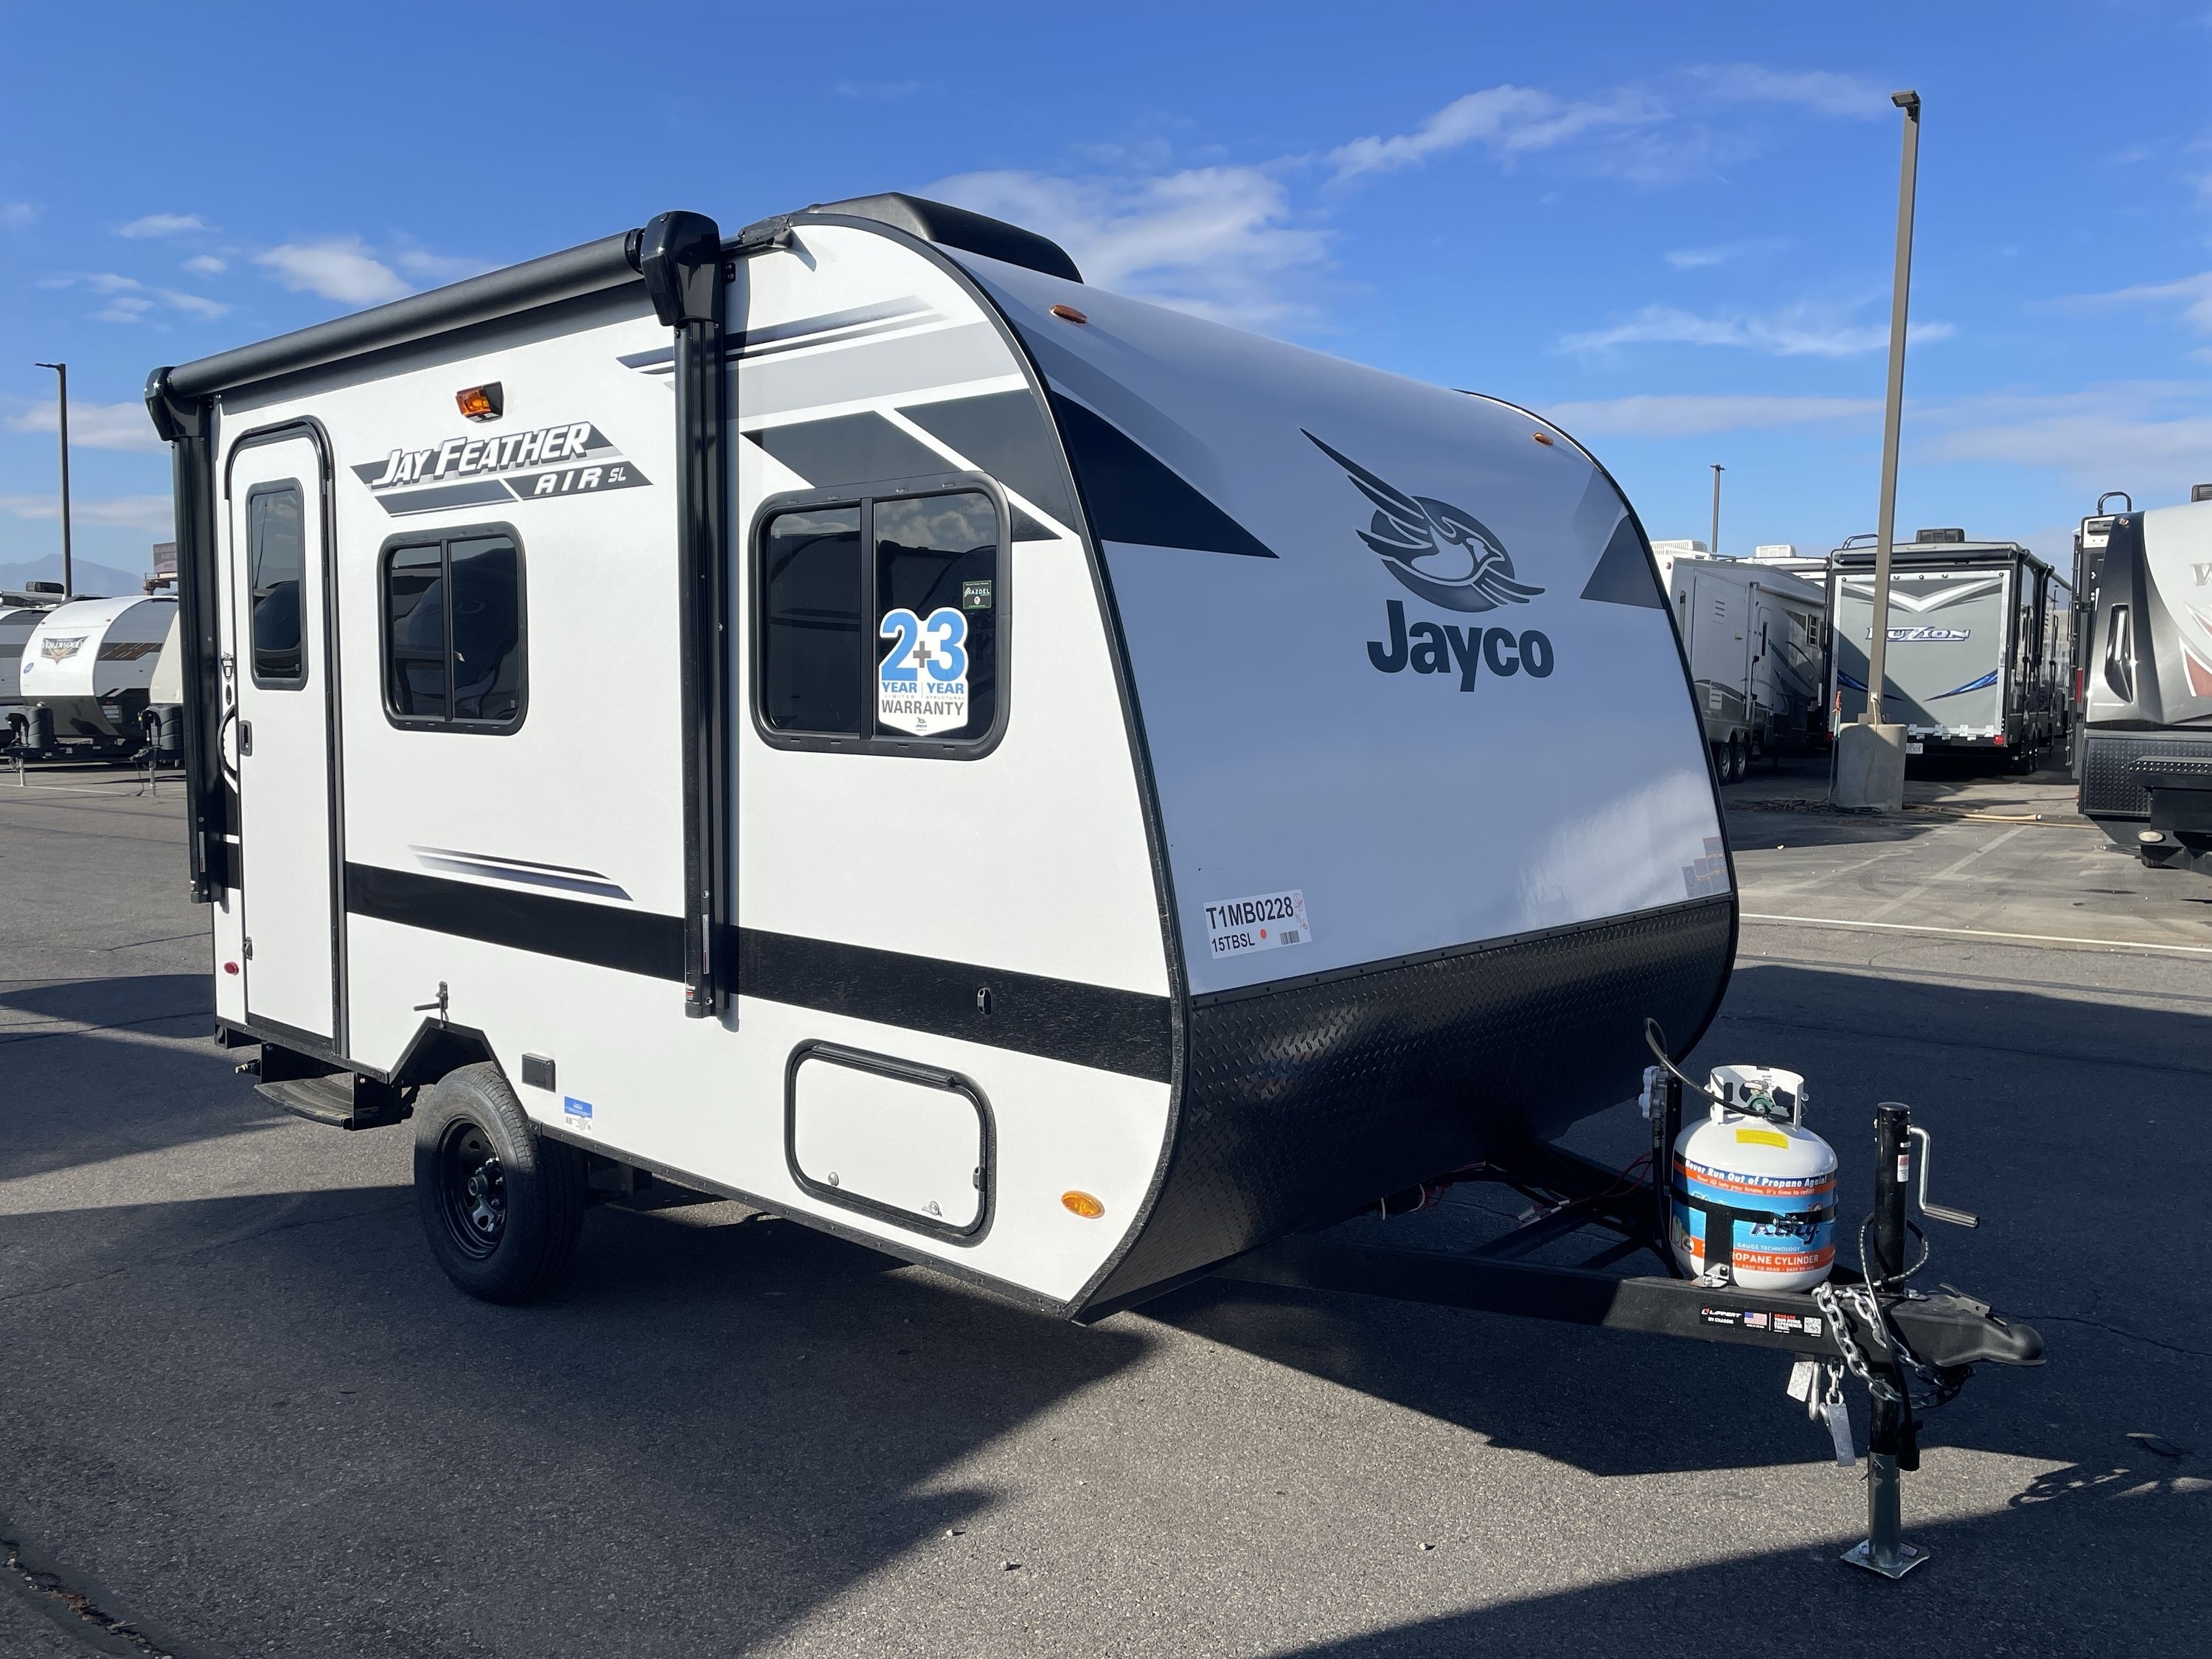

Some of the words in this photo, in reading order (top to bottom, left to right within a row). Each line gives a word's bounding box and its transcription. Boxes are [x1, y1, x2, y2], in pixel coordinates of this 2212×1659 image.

[371, 448, 431, 490] JAY
[434, 421, 591, 479] FEATHER
[533, 467, 602, 495] AIR
[608, 467, 627, 483] SL
[1865, 626, 1971, 642] UZION
[1366, 599, 1554, 692] Jayco
[881, 682, 917, 693] YEAR
[926, 683, 964, 694] YEAR
[881, 699, 964, 715] WARRANTY
[1206, 897, 1294, 929] T1MB0228
[1211, 932, 1256, 953] 15TBSL
[1685, 1159, 1706, 1174] Never
[1707, 1167, 1725, 1179] Run
[1727, 1172, 1746, 1183] Out
[1747, 1176, 1760, 1186] of
[1761, 1178, 1803, 1189] Propane
[1804, 1175, 1827, 1188] Again!
[1731, 1184, 1743, 1192] you
[1745, 1186, 1764, 1194] know,
[1775, 1254, 1819, 1265] CYLINDER
